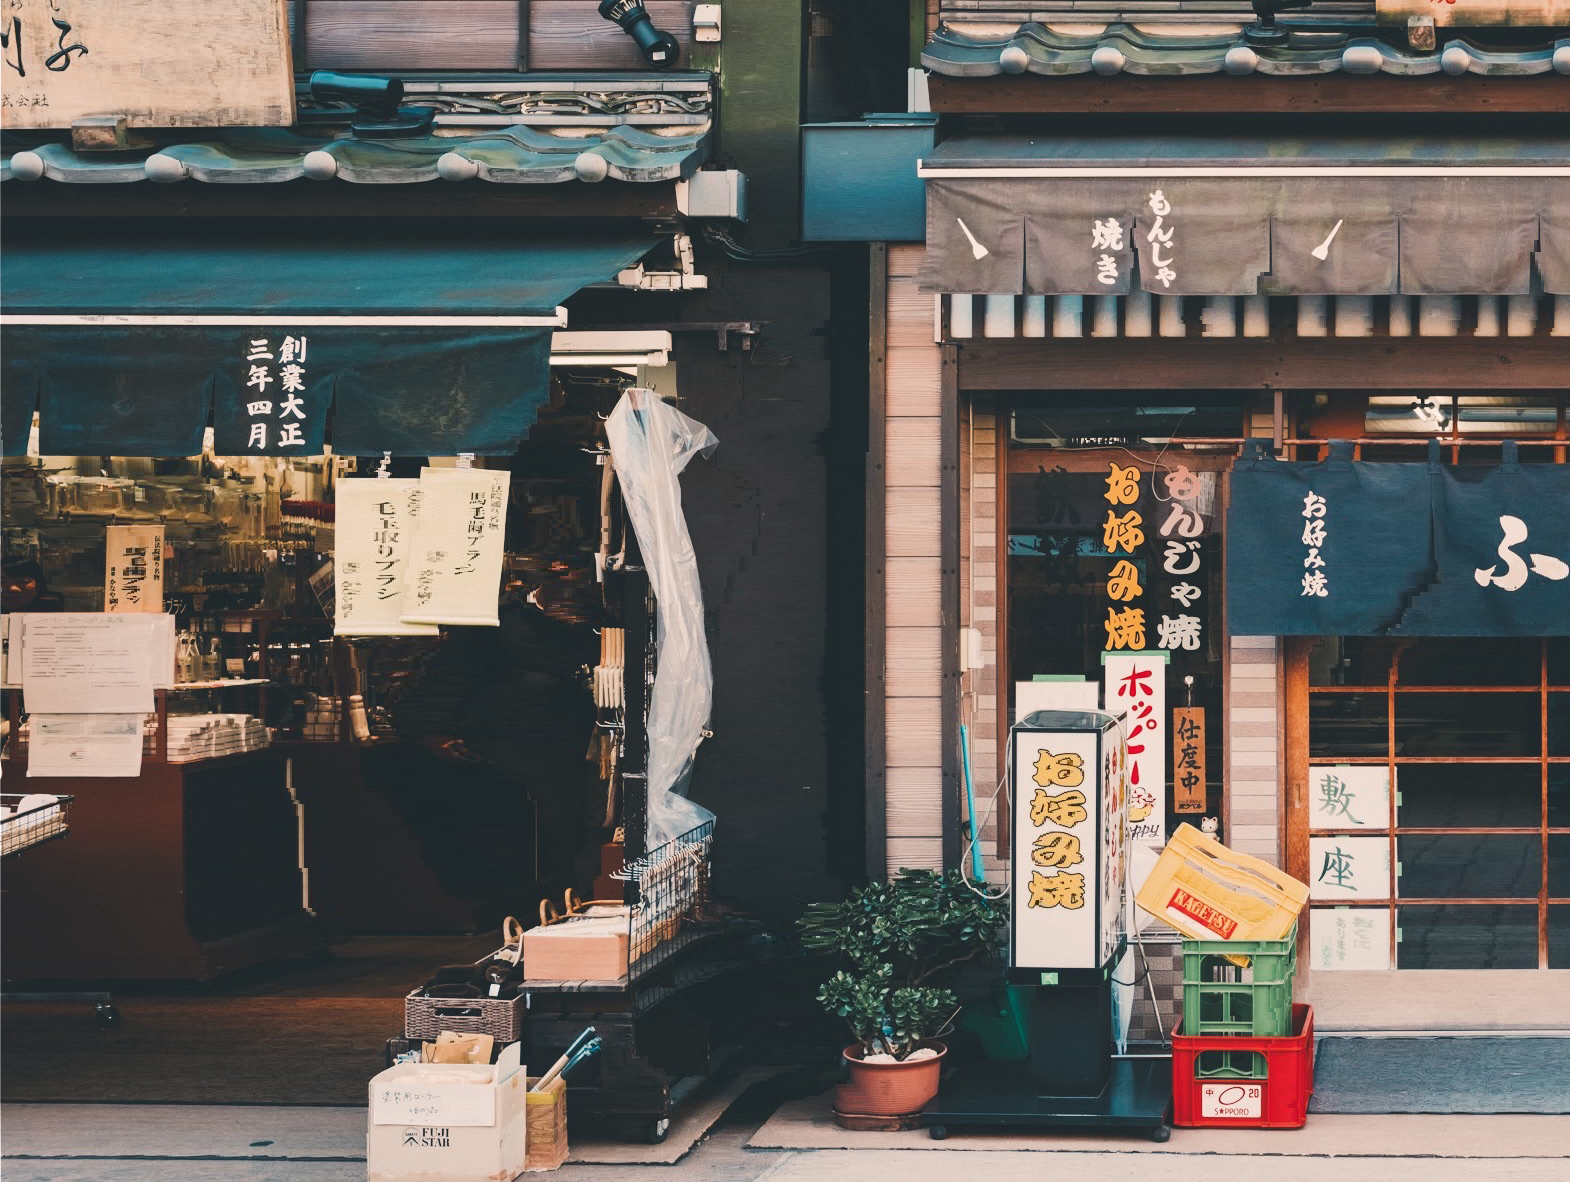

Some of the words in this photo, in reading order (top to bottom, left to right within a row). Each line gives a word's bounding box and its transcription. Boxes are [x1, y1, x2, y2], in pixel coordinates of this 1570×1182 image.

[1091, 217, 1124, 285] 焼き
[1147, 189, 1177, 288] もんじゃ
[246, 338, 274, 450] 三年四月
[278, 335, 307, 448] 創業大正
[1103, 462, 1146, 651] お好み焼
[1156, 465, 1202, 651] もんじゃ焼
[1301, 490, 1329, 598] お好み焼
[1117, 661, 1158, 786] ホッピー
[1177, 717, 1202, 796] 仕度中
[1027, 748, 1088, 911] お好み焼
[1318, 773, 1364, 824] 敷
[1173, 890, 1236, 934] KAGETSU
[1318, 846, 1358, 892] 座
[422, 1128, 449, 1137] FUJI
[1206, 1089, 1213, 1097] 中
[1249, 1089, 1259, 1098] 20
[422, 1137, 450, 1147] STAR
